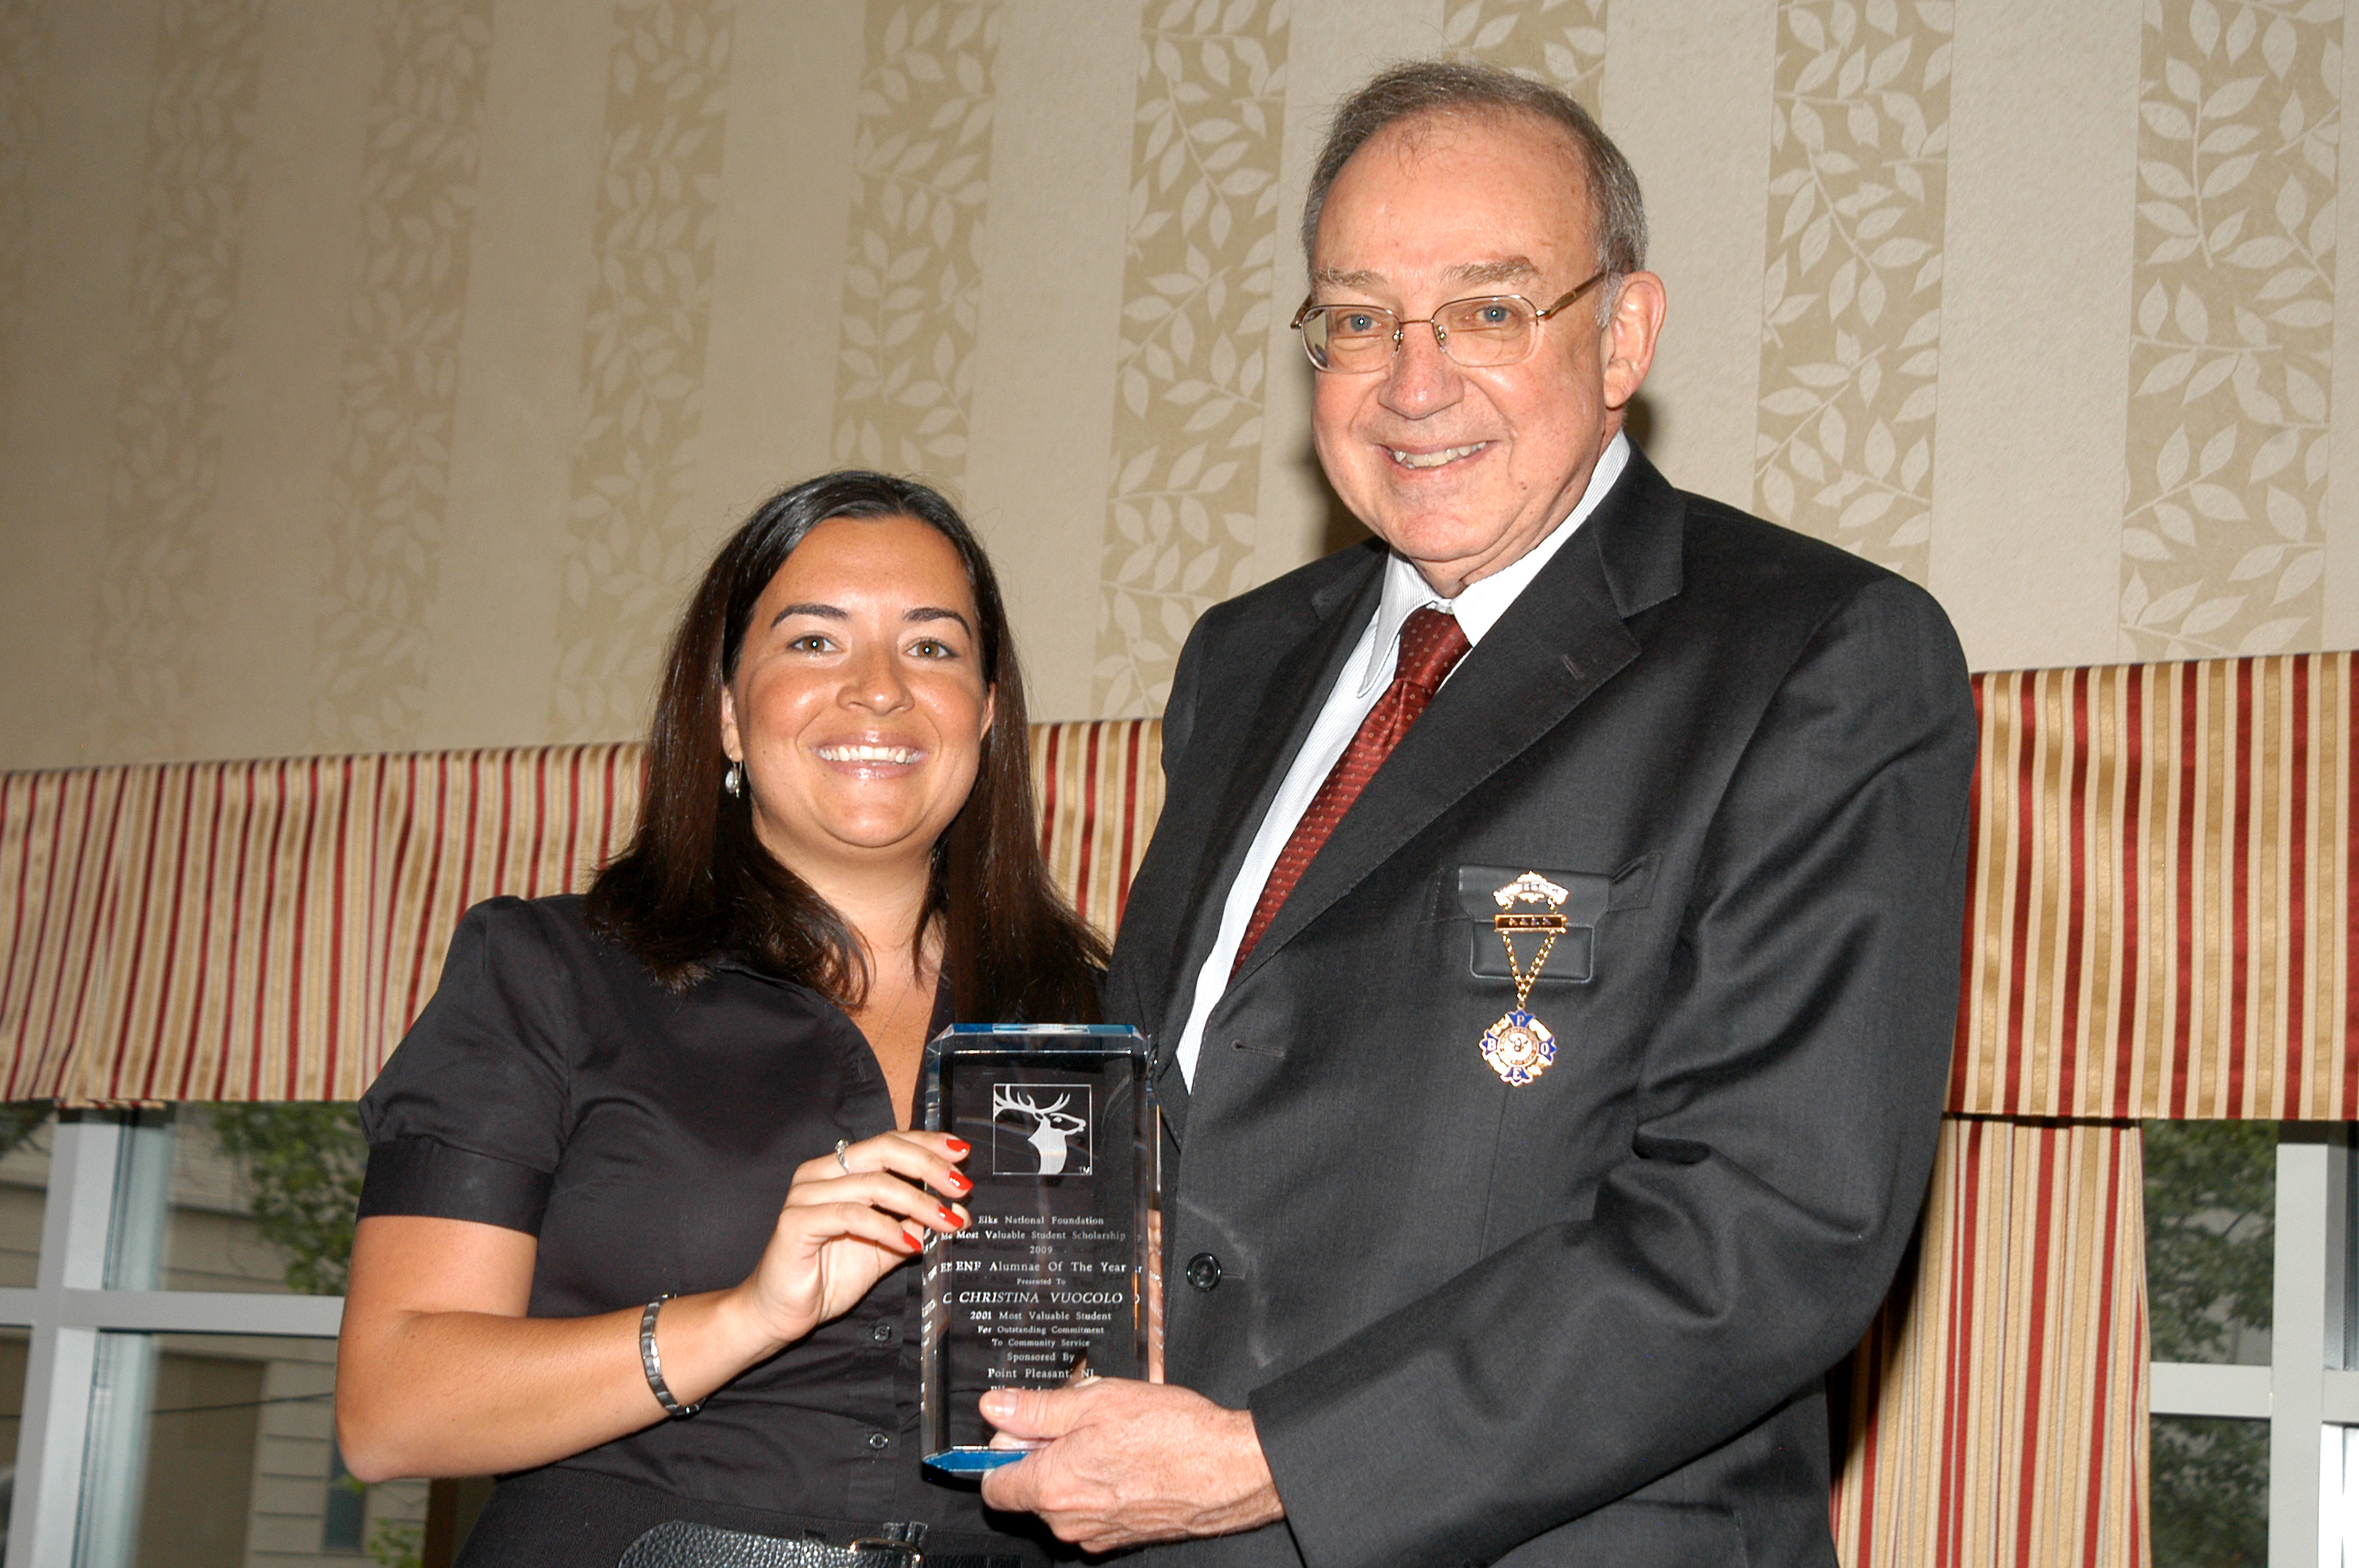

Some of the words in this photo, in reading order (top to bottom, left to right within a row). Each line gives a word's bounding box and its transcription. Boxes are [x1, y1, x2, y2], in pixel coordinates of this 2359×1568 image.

[1516, 1014, 1525, 1026] P
[1487, 1038, 1497, 1051] B
[1005, 1215, 1044, 1225] National
[1052, 1215, 1103, 1225] Foundation
[956, 1230, 979, 1239] Most
[985, 1230, 1025, 1239] Valuable
[1031, 1230, 1066, 1239] Student
[1072, 1230, 1125, 1240] Scholarship
[1030, 1245, 1052, 1254] 2009
[956, 1261, 981, 1271] ENF
[989, 1261, 1040, 1271] Alumnae
[1048, 1261, 1063, 1272] Of
[1070, 1261, 1093, 1272] The
[1100, 1261, 1126, 1272] Year
[958, 1292, 1039, 1303] CHRISTINA
[1051, 1292, 1123, 1303] VUOCOLO
[970, 1311, 991, 1320] 2001
[999, 1311, 1022, 1320] Most
[1029, 1311, 1070, 1320] Valuable
[1076, 1311, 1111, 1320] Student
[997, 1326, 1046, 1335] Outstanding
[1008, 1338, 1056, 1348] Community
[1061, 1338, 1090, 1347] Service
[1007, 1352, 1056, 1363] Sponsored
[1063, 1352, 1075, 1363] By
[987, 1368, 1016, 1378] Point
